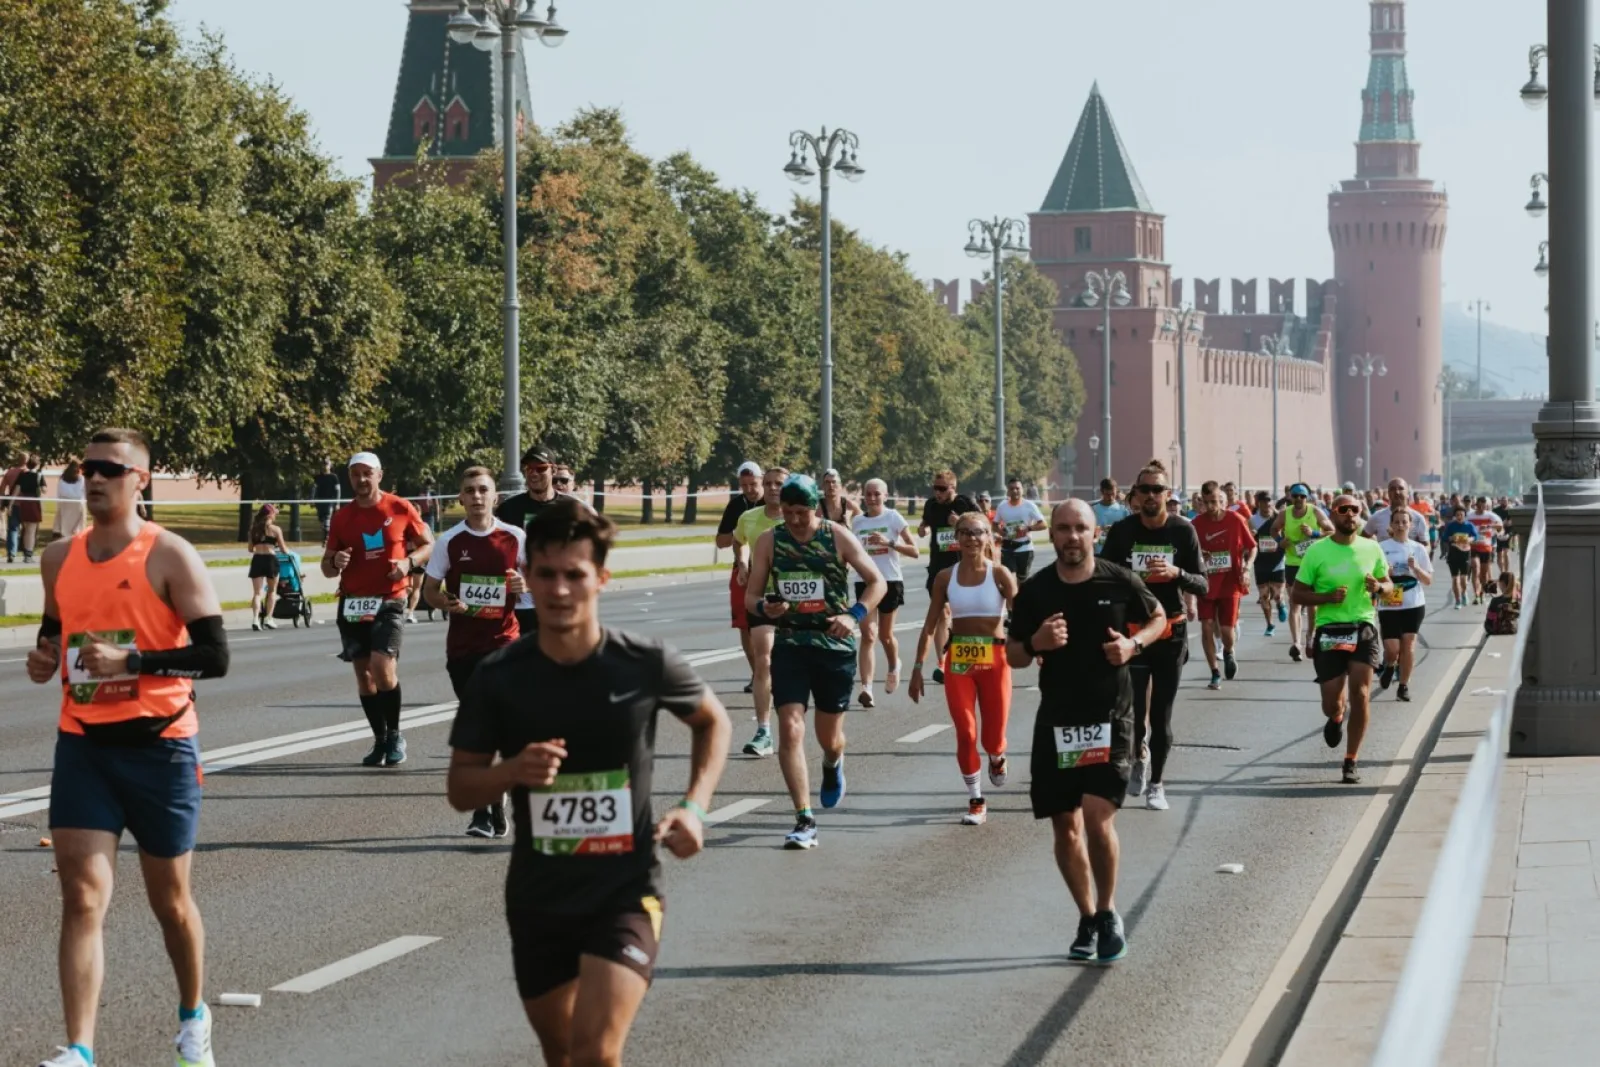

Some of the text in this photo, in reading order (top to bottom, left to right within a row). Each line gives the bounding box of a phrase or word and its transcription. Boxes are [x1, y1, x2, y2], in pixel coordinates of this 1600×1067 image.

[465, 585, 501, 600] 6464
[783, 581, 817, 595] 5039
[348, 600, 377, 611] 4182
[955, 645, 986, 658] 3901
[1062, 723, 1103, 744] 5152
[541, 795, 617, 825] 4783
